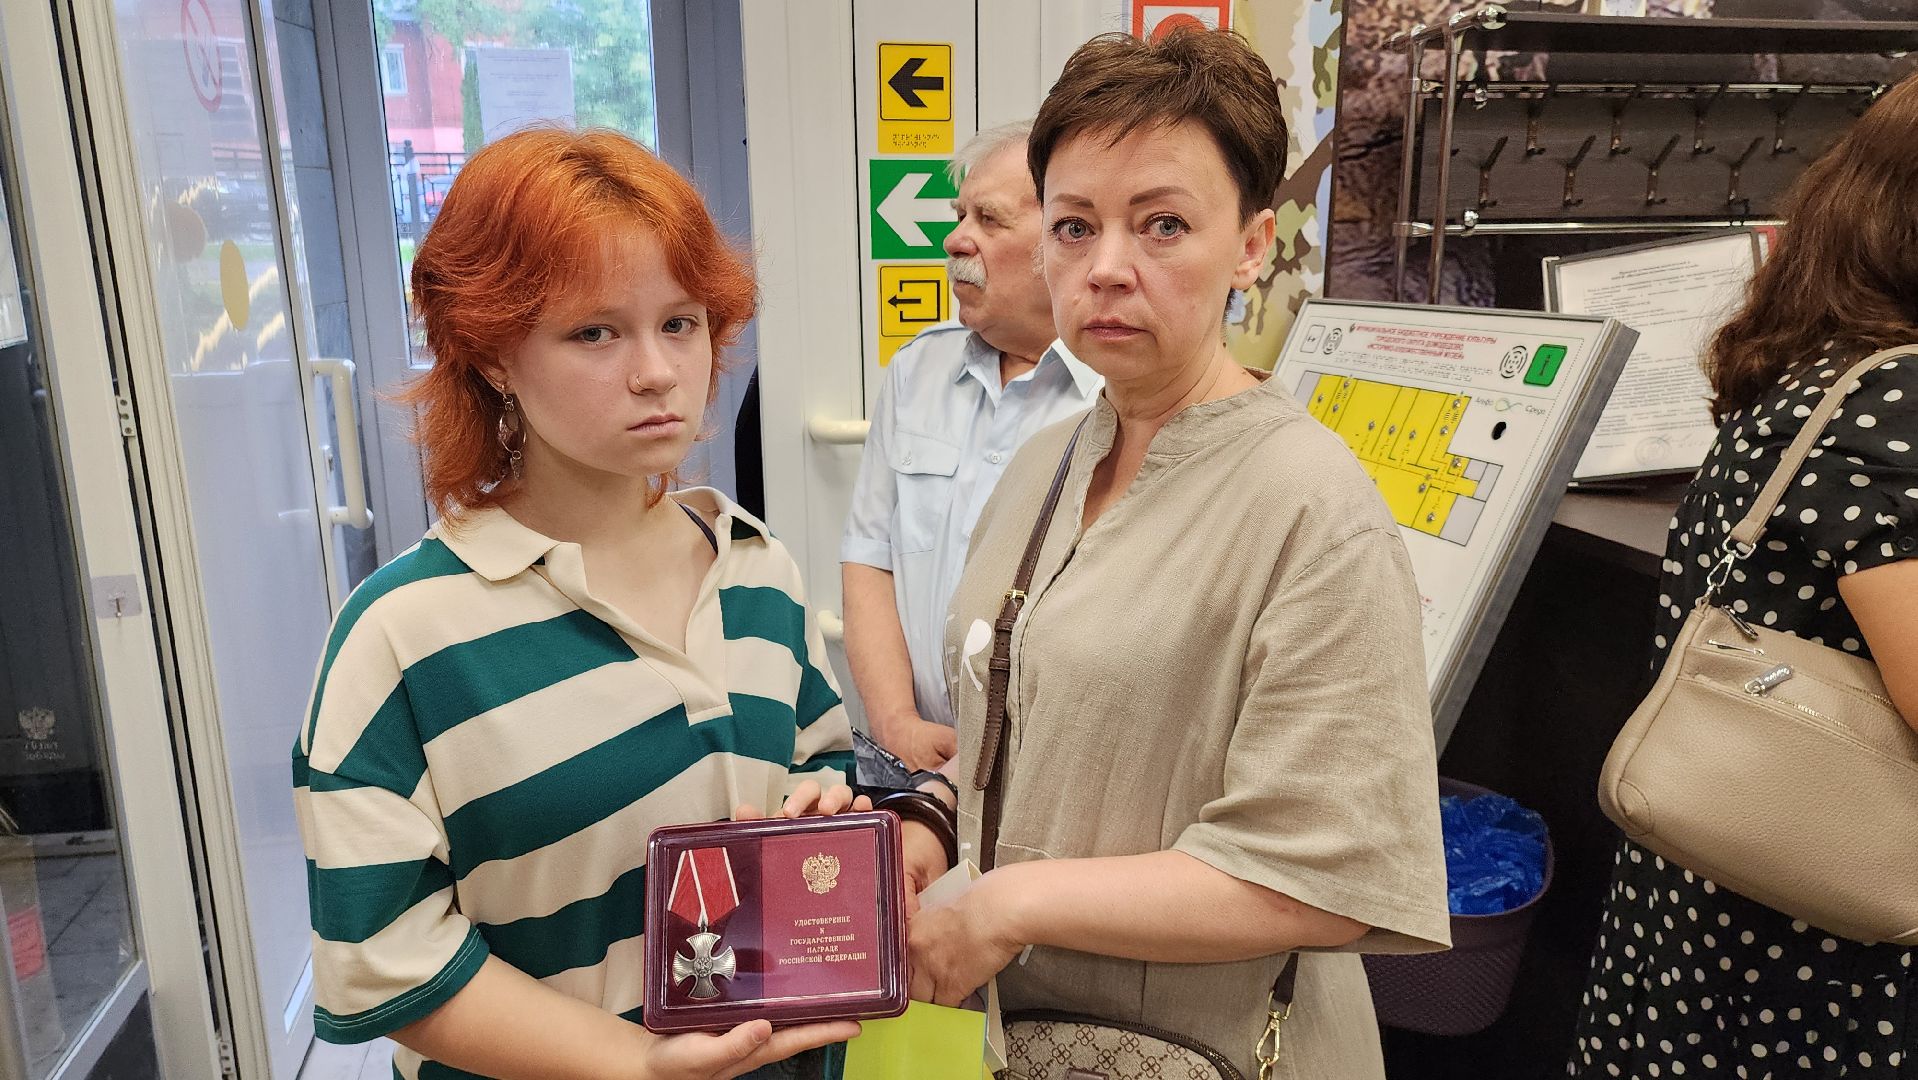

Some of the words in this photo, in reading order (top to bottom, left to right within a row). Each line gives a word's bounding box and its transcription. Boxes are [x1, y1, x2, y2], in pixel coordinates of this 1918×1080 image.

[794, 916, 851, 927] УДОСТОВЕРЕНИЕ
[790, 934, 855, 945] ГОСУДАРСТВЕННОЙ
[807, 945, 839, 954] НАГРАДЕ
[779, 954, 823, 965] РОССИЙСКОЙ
[824, 952, 867, 962] ФЕДЕРАЦИИ
